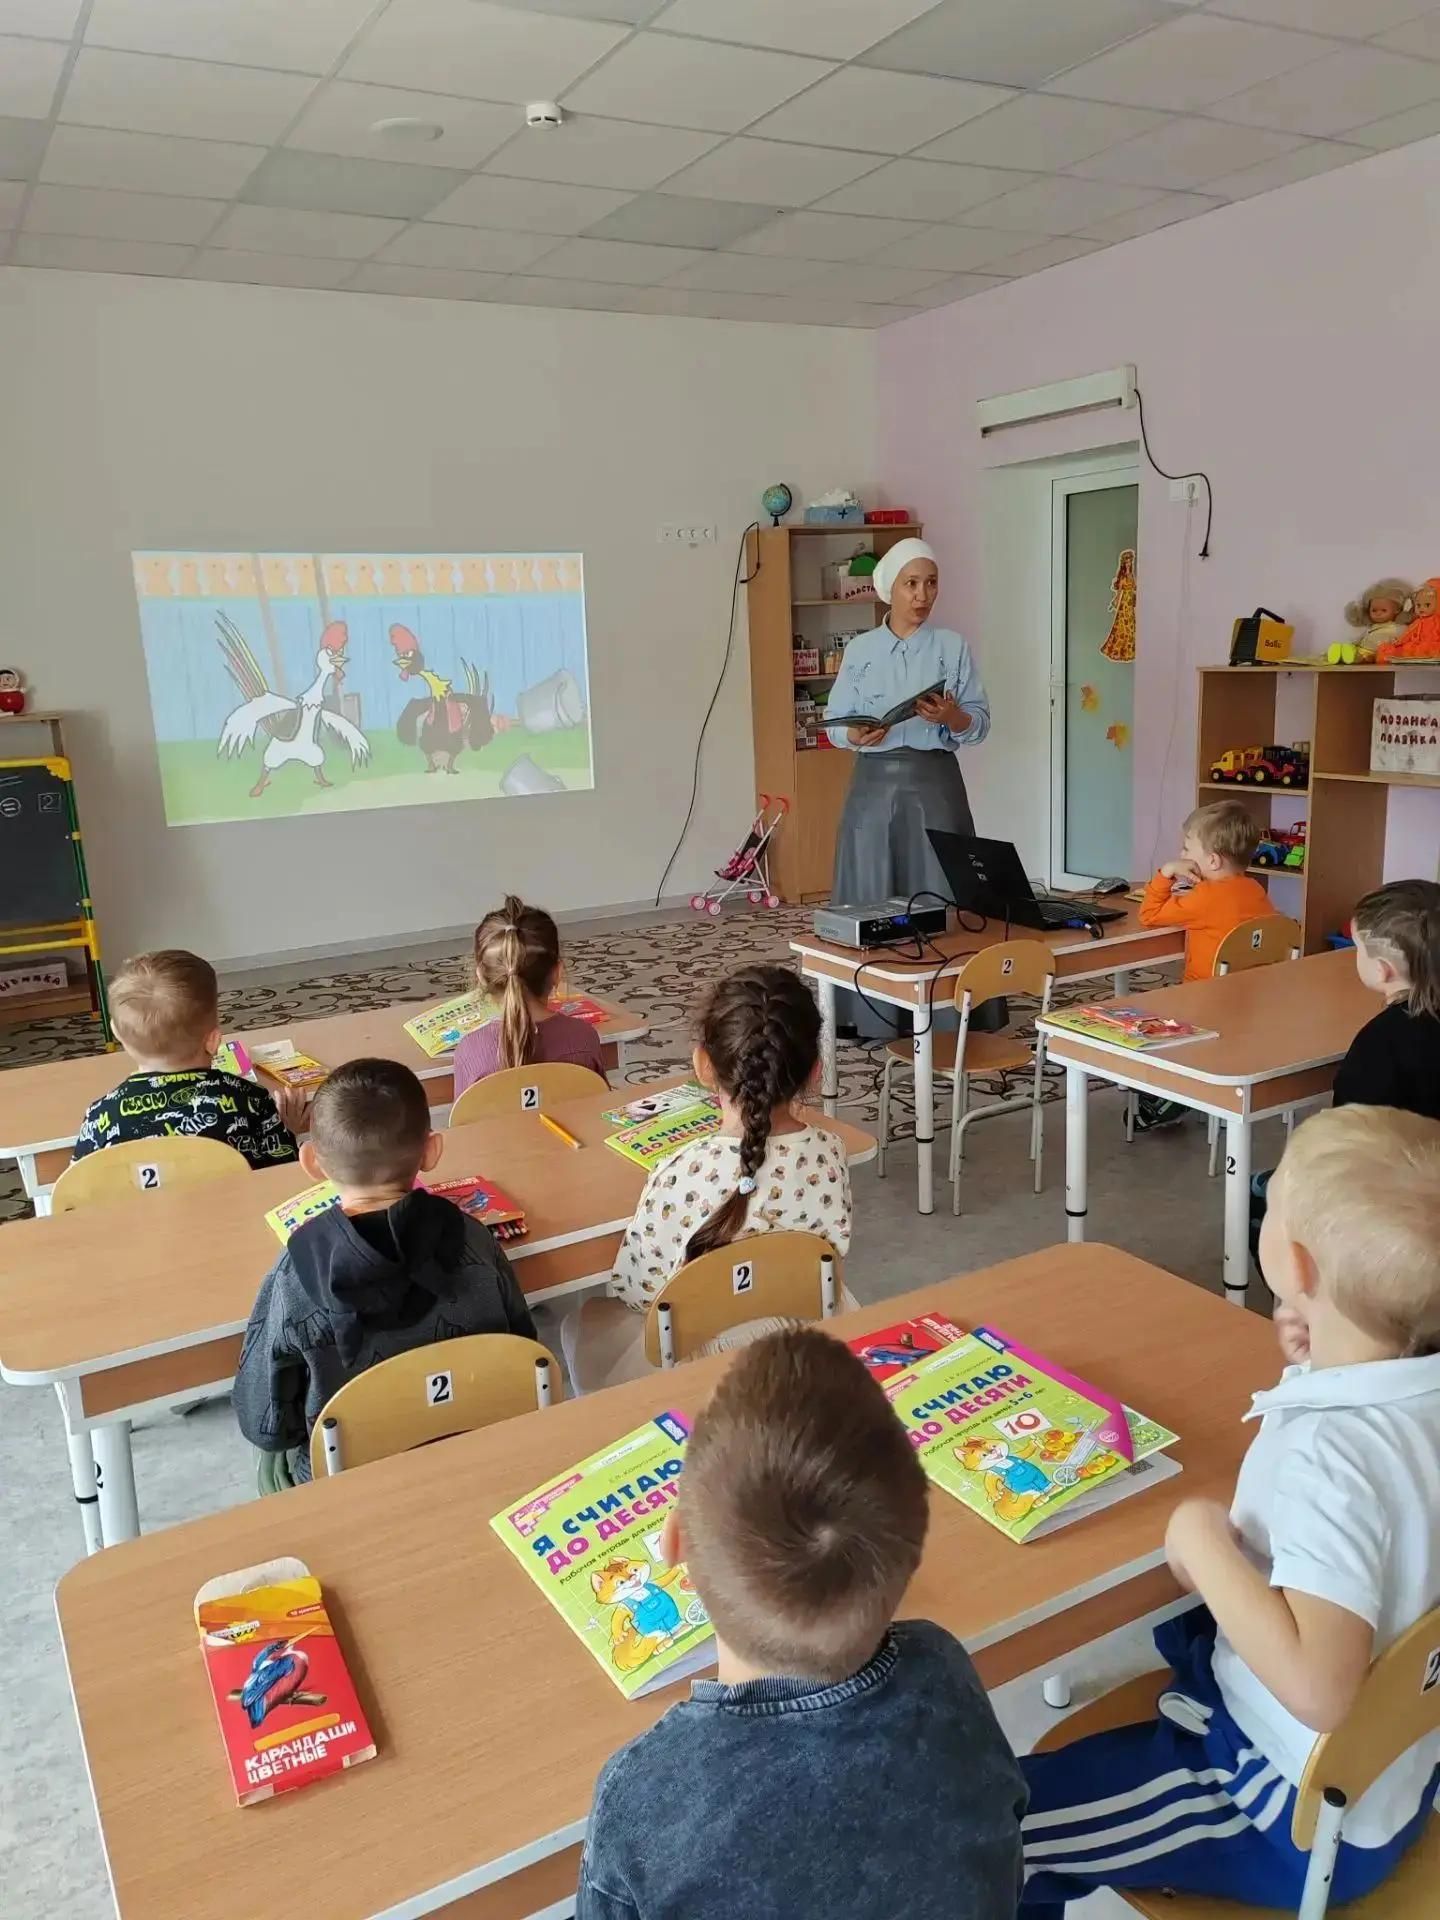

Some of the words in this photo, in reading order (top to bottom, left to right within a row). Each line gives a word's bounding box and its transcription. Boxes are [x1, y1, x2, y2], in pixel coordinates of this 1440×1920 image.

[1252, 933, 1261, 948] 2
[1003, 959, 1012, 974] 2
[914, 1039, 921, 1055] 2
[524, 1088, 536, 1108] 2
[647, 1113, 718, 1142] СЧИТАЮ
[1226, 1155, 1236, 1175] 2
[142, 1169, 158, 1188] 2
[303, 1195, 343, 1217] СЧИ
[736, 1266, 751, 1290] 2
[431, 1375, 450, 1403] 2
[911, 1364, 1014, 1420] СЧИТАЮ
[906, 1421, 944, 1449] ДО
[943, 1374, 1034, 1425] ДЕСЯТИ
[1002, 1412, 1042, 1436] 10
[532, 1534, 555, 1557] Я
[561, 1458, 686, 1536] СЧИТАЮ
[546, 1536, 590, 1577] ДО
[595, 1480, 681, 1542] ДЕСЯТ
[559, 1557, 598, 1586] Рабочая
[244, 1720, 357, 1772] КАРАНДАШИ
[248, 1744, 328, 1784] ЦВЕТНЫЕ
